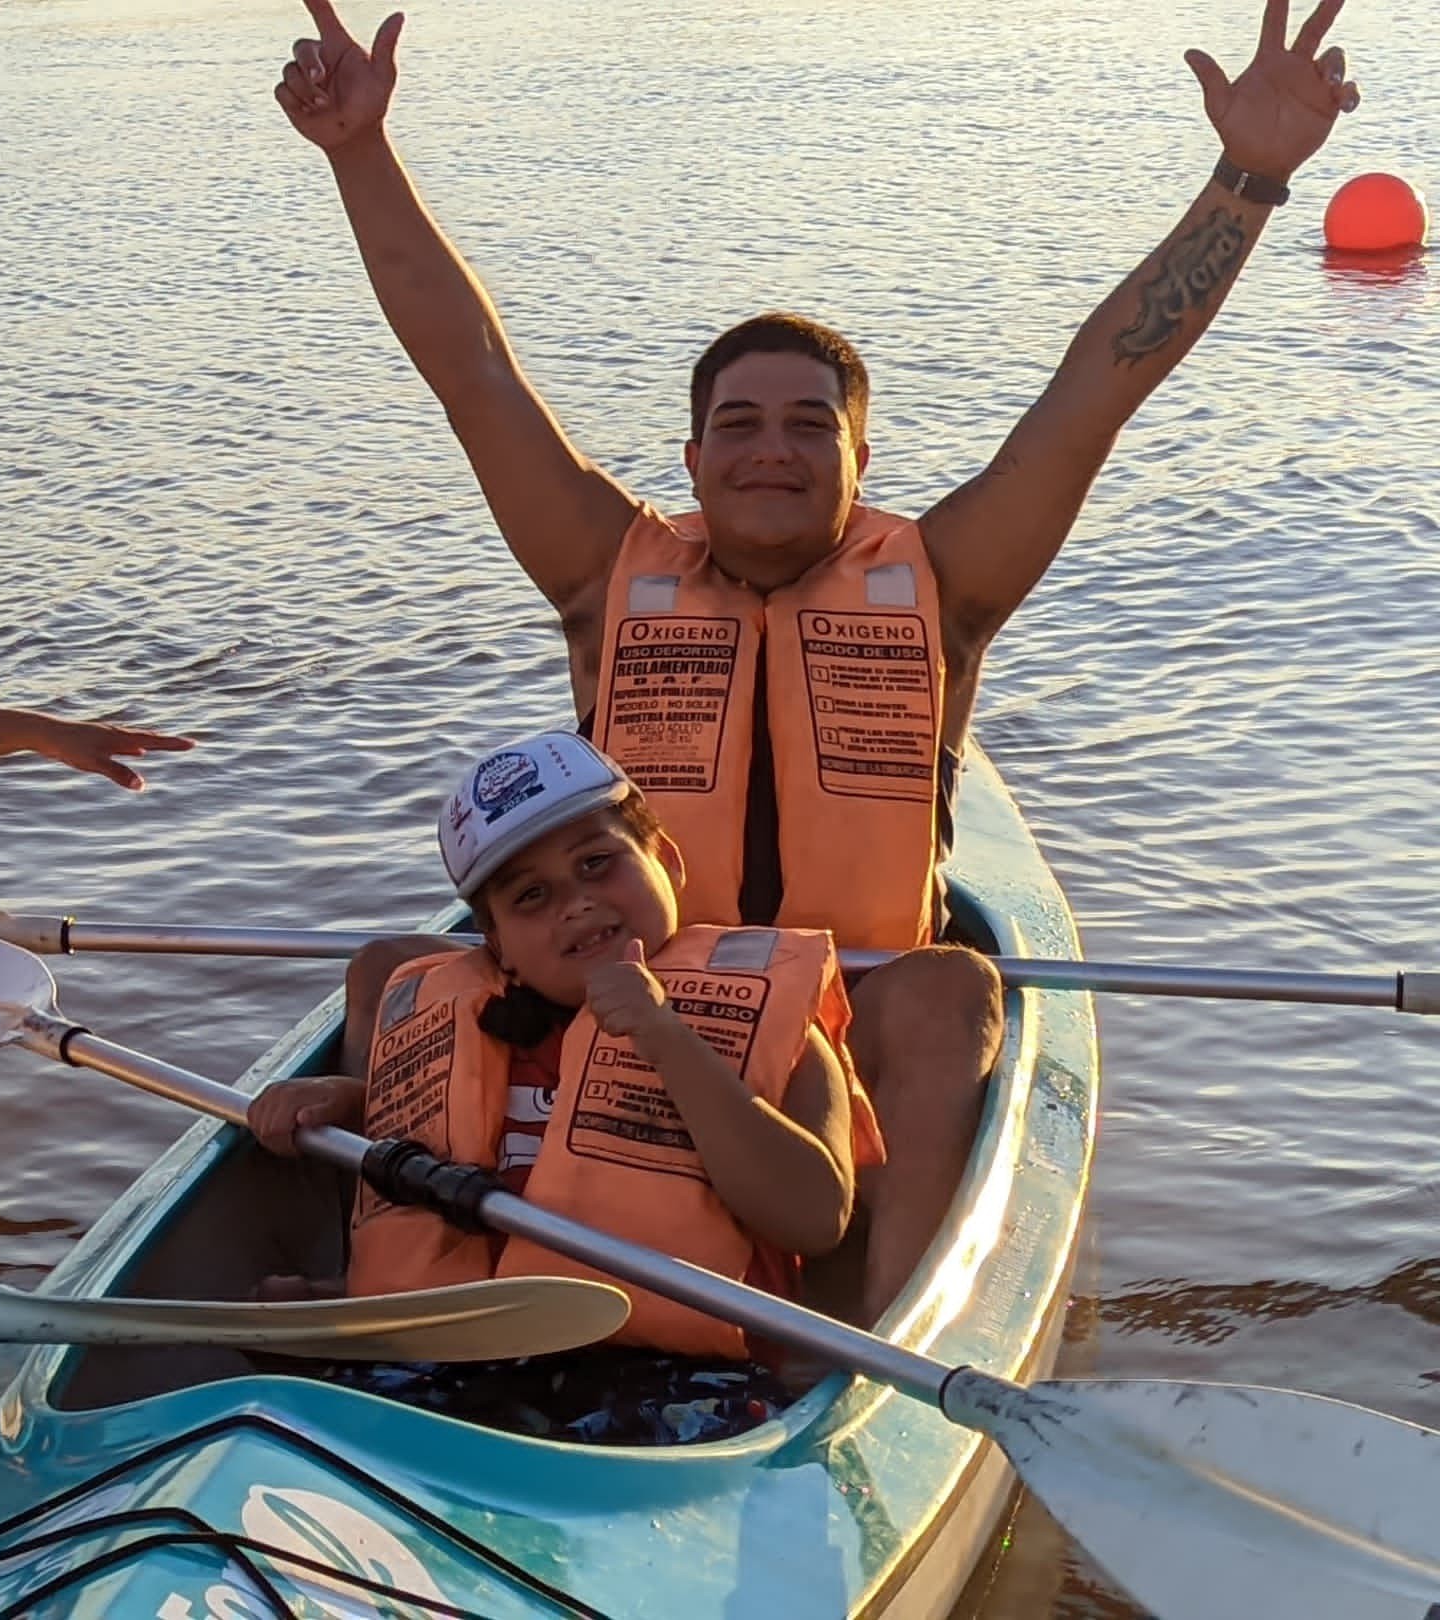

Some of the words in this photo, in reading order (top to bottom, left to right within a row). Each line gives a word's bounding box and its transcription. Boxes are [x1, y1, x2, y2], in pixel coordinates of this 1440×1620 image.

[631, 622, 729, 641] OXIGENO
[812, 616, 915, 640] OXIGENO
[621, 648, 649, 658] USO
[653, 646, 732, 657] DEPORTIVO
[807, 642, 859, 656] MODO
[863, 647, 885, 658] DE
[890, 648, 925, 659] USO
[616, 660, 730, 677] REGLAMENTARIO
[621, 764, 705, 775] OMOLOGADO
[662, 978, 752, 1000] XIGENO
[679, 1000, 705, 1014] DE
[711, 1005, 754, 1021] USO
[382, 1003, 449, 1058] OXIGENO
